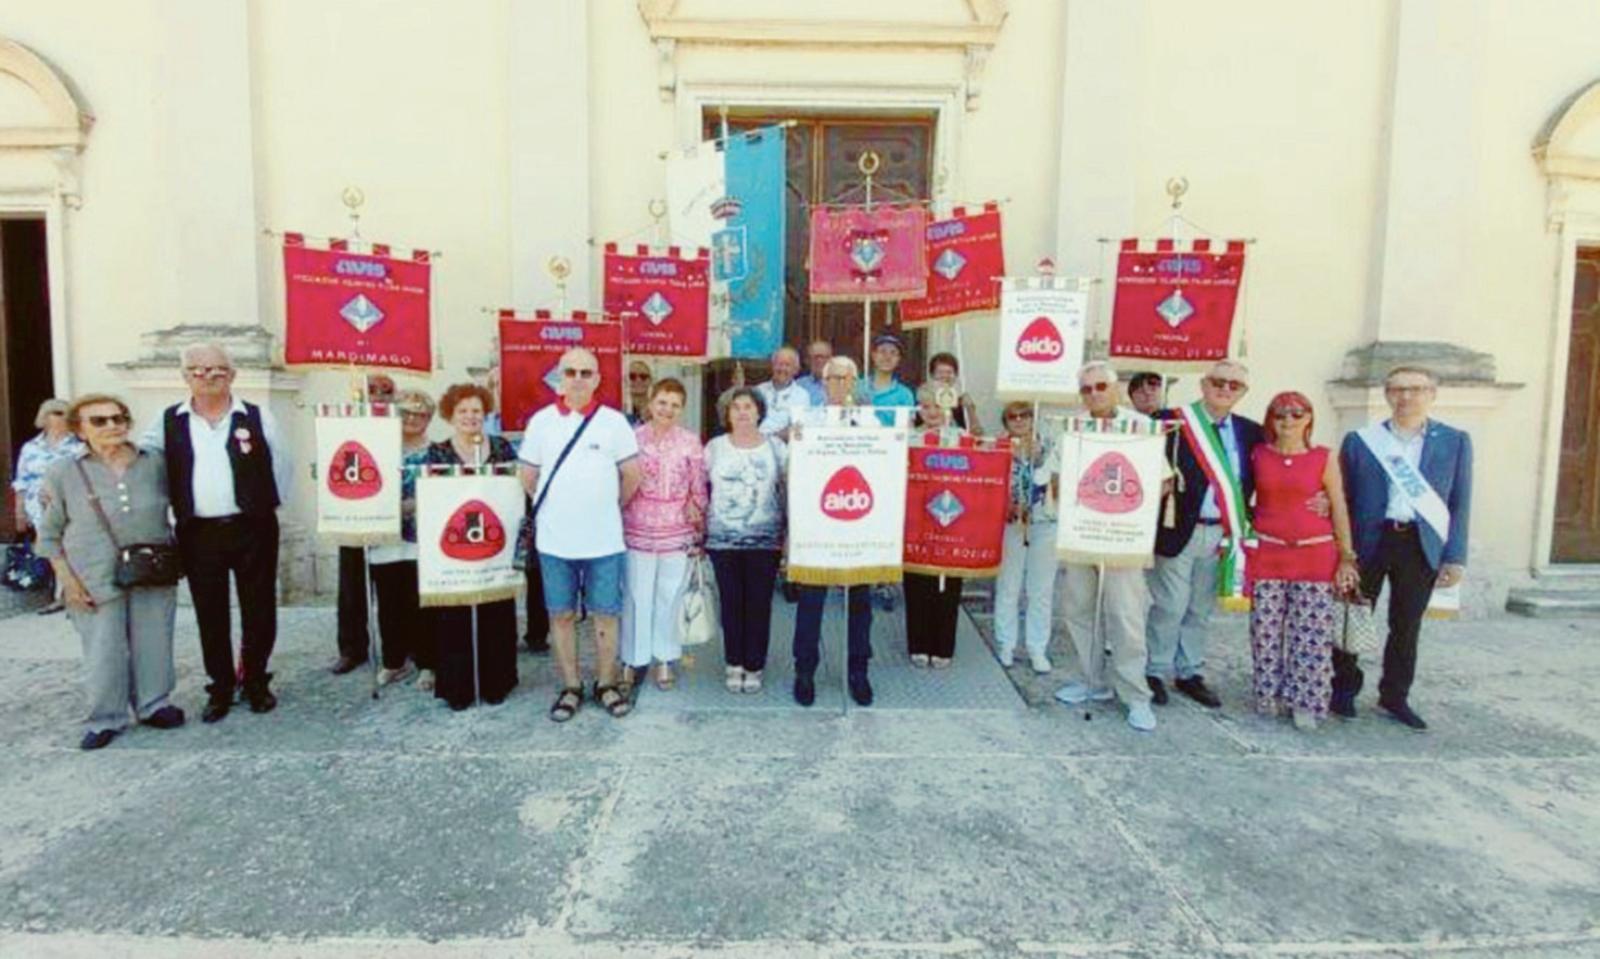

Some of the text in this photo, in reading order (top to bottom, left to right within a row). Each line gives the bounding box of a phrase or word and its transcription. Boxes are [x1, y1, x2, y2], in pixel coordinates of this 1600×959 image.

[336, 259, 386, 277] AVIS
[640, 261, 677, 275] AVIS
[1018, 335, 1061, 356] aido
[311, 350, 412, 366] MARDIMAGO
[925, 453, 970, 471] AVIS
[824, 488, 871, 511] aido
